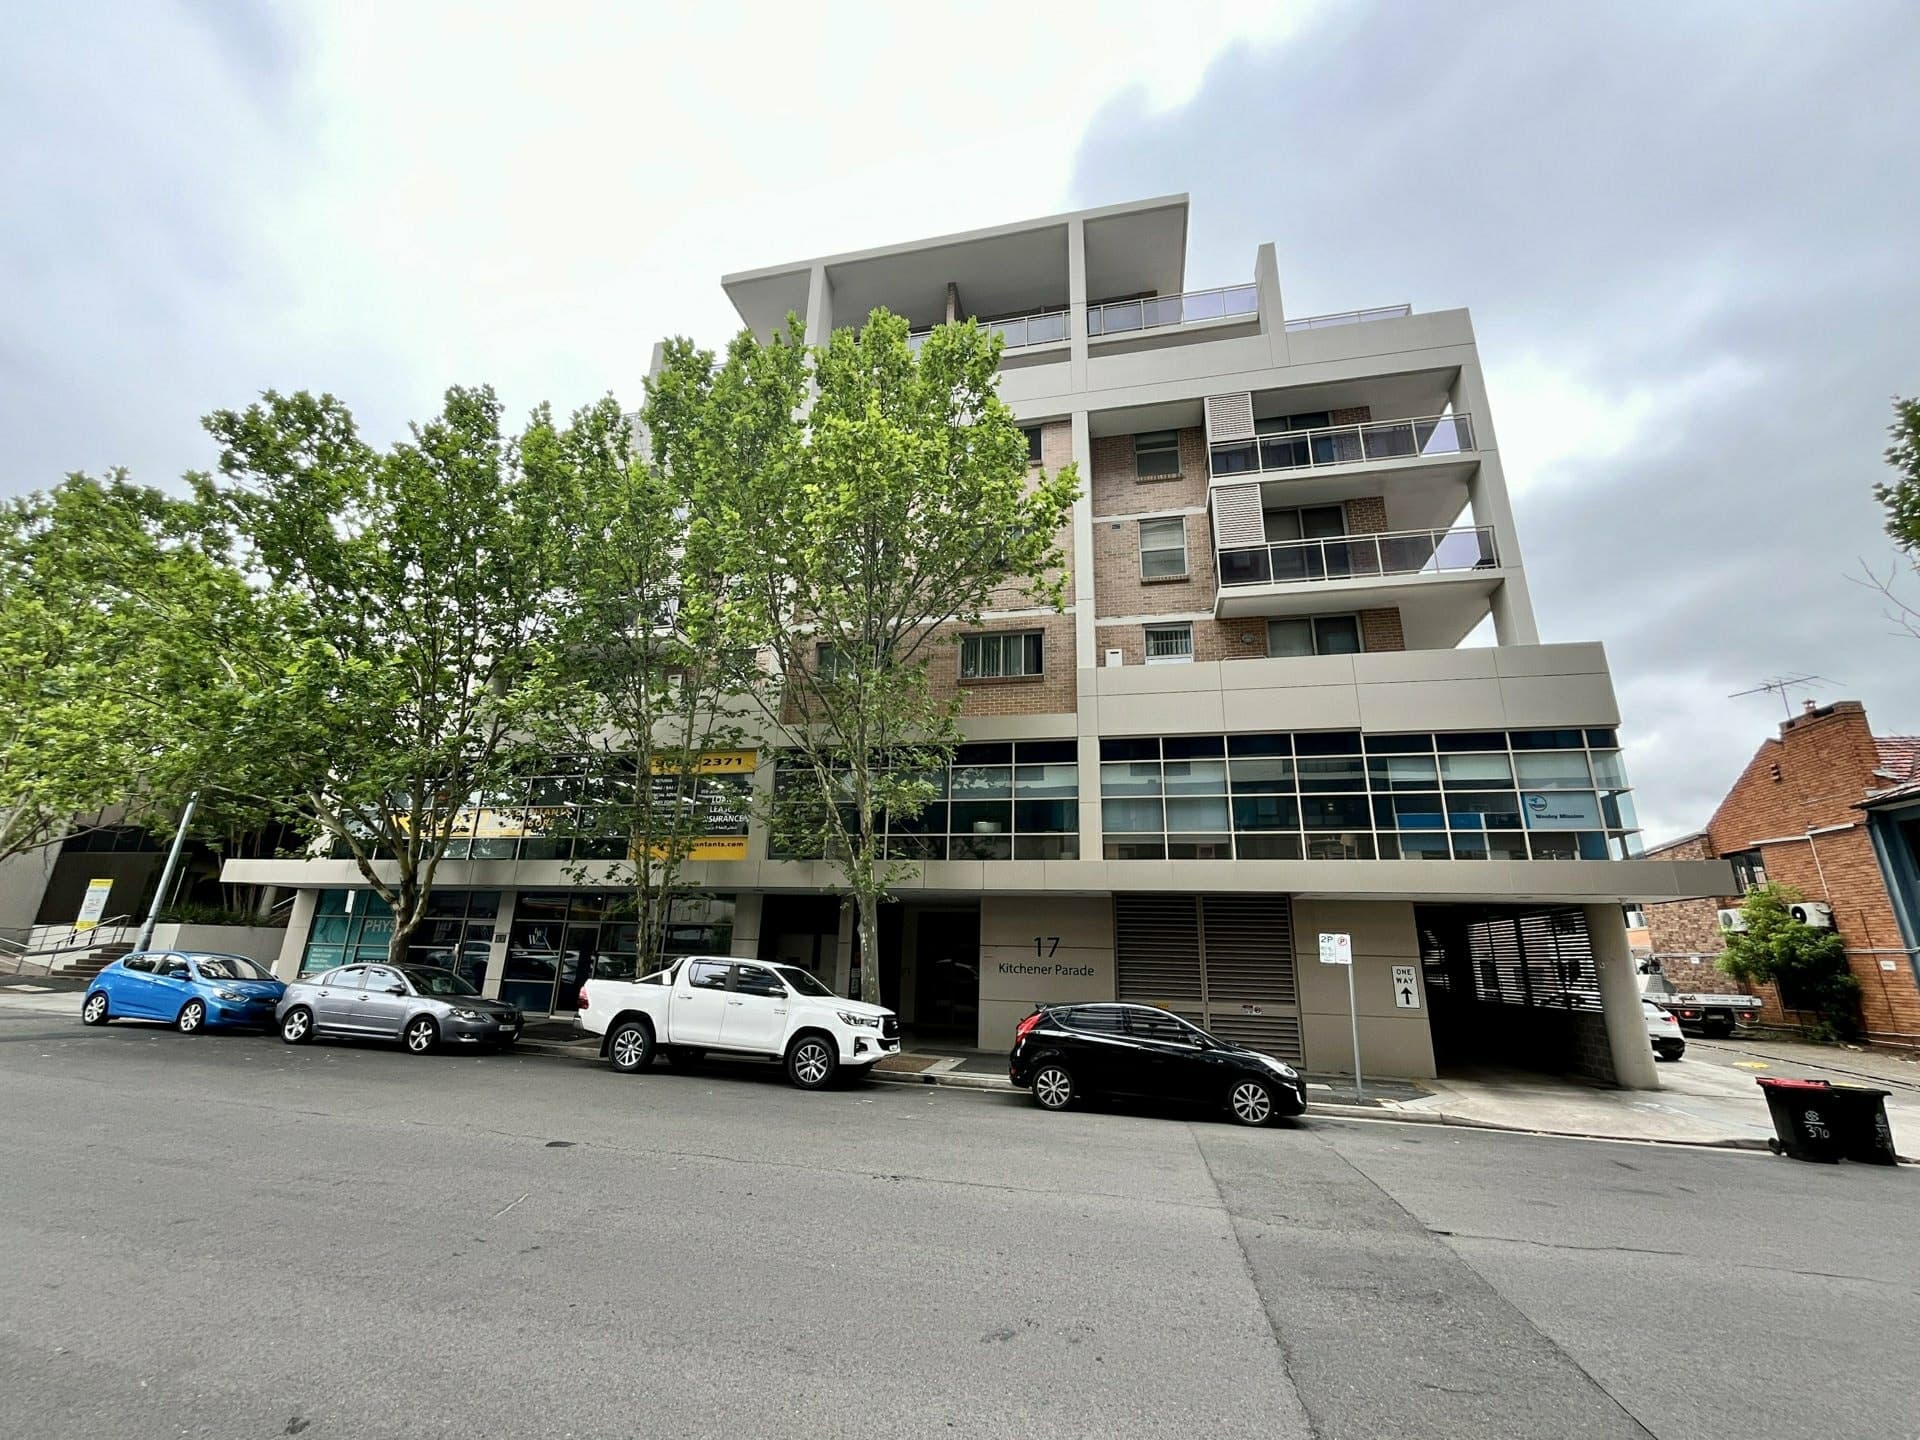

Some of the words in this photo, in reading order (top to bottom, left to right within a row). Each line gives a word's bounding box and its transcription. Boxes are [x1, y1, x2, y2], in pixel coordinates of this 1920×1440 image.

[702, 758, 742, 766] 2371
[1321, 935, 1333, 943] 2P
[1034, 937, 1060, 958] 17
[999, 962, 1052, 975] Kitchener
[1055, 964, 1094, 976] Parade
